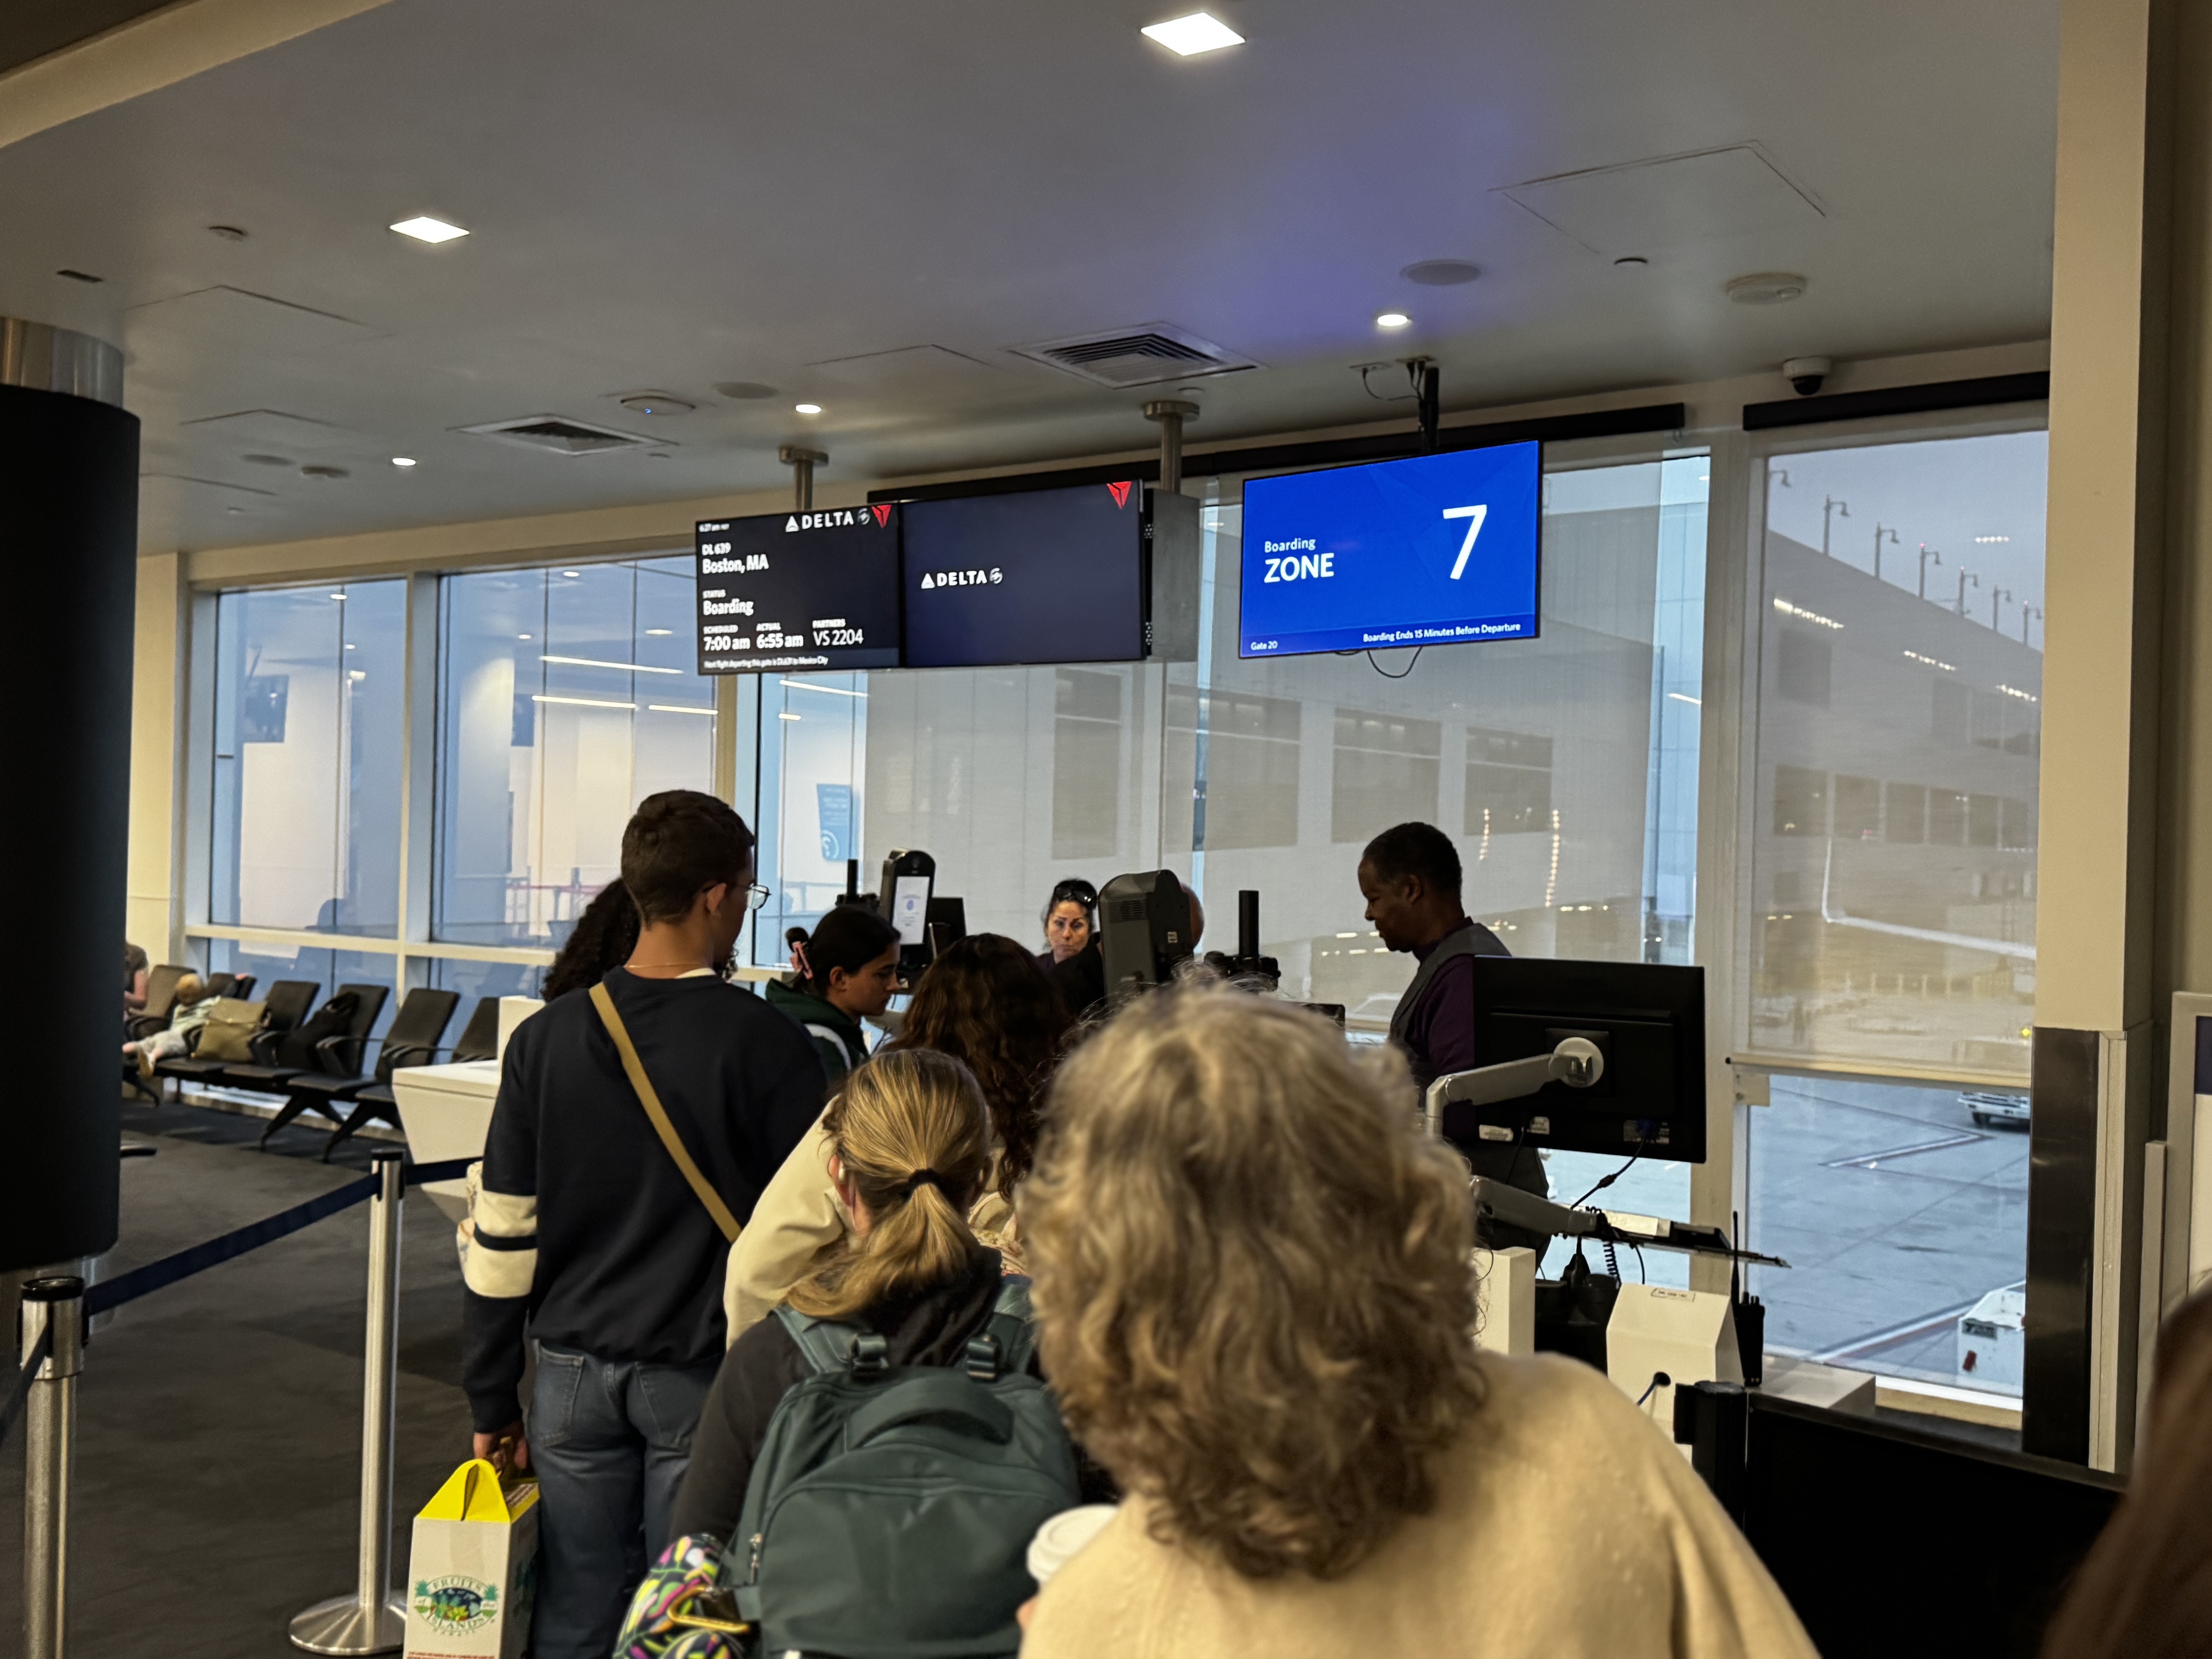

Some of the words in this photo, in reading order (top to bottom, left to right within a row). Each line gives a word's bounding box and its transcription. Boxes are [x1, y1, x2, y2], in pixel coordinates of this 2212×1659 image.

[802, 511, 854, 529] DELTA
[702, 544, 713, 555] DL
[713, 543, 731, 554] 639
[1265, 538, 1316, 553] Boarding
[1443, 505, 1487, 579] 7
[702, 558, 745, 574] Boston,
[747, 554, 769, 570] MA
[1264, 553, 1334, 583] ZONE
[937, 570, 987, 586] DELTA
[703, 598, 754, 616] Boarding
[756, 623, 781, 631] ACTUAL
[1364, 633, 1395, 642] Boarding
[1396, 631, 1413, 639] Ends
[1415, 630, 1423, 638] 15
[1424, 629, 1454, 637] Minutes
[1456, 626, 1480, 635] Before
[1482, 624, 1520, 633] Departure
[704, 635, 731, 651] 7:00
[732, 638, 750, 650] am
[757, 633, 783, 649] 6:55
[785, 635, 803, 647] am
[813, 630, 830, 646] VS
[832, 629, 863, 645] 2204
[1251, 642, 1267, 650] Gate
[1268, 641, 1278, 649] 20
[817, 656, 828, 665] City
[433, 1577, 483, 1592] FRUITS
